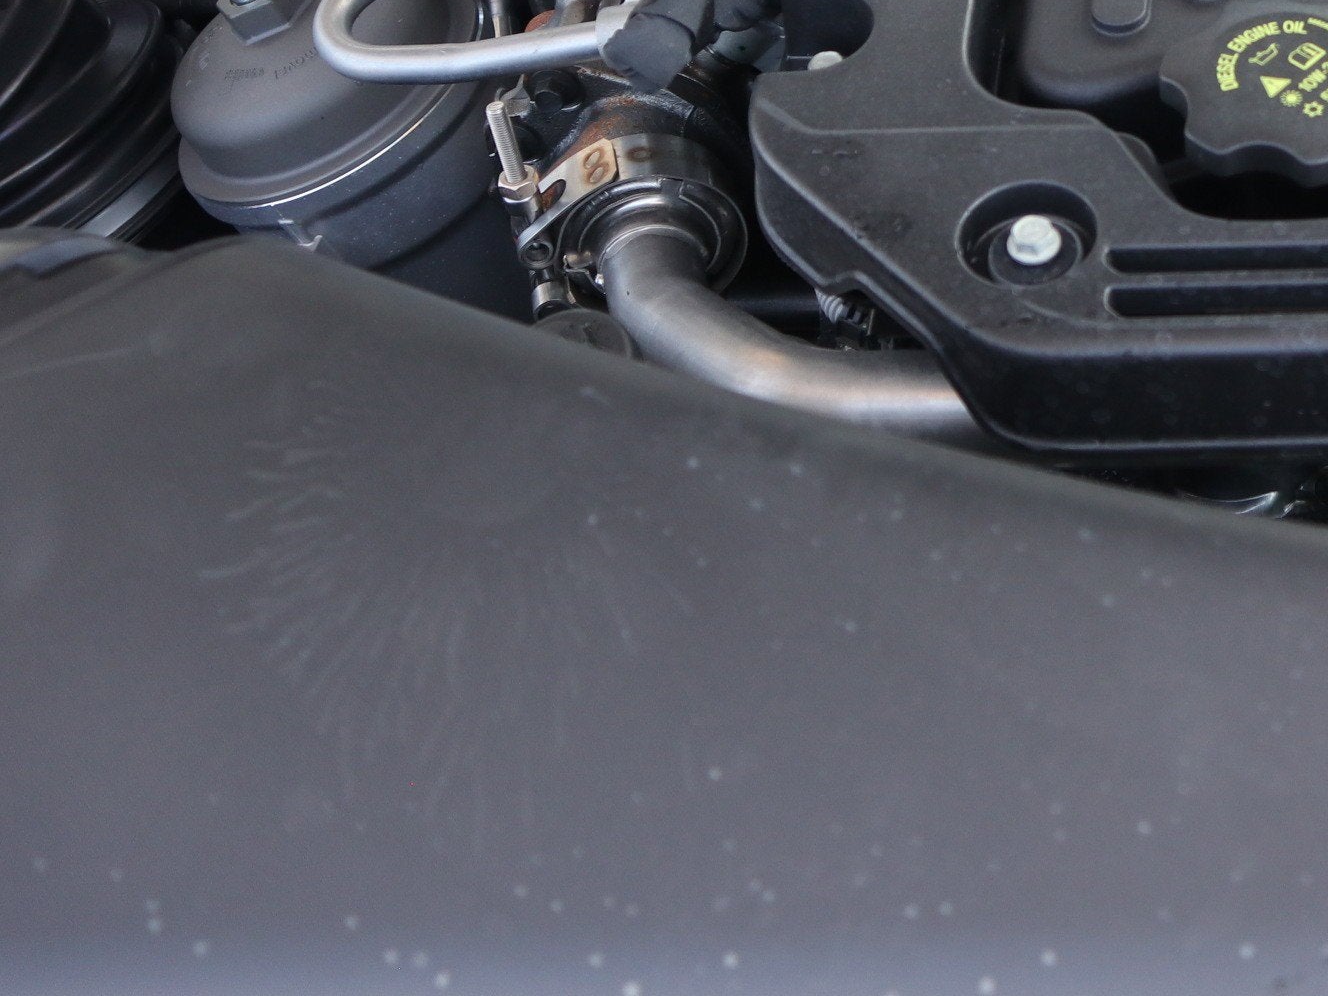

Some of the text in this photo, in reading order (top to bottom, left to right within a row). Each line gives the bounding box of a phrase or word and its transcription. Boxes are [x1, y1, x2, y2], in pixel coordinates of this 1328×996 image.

[1227, 21, 1281, 53] ENGINE
[1283, 20, 1307, 35] OIL
[1216, 53, 1240, 92] DIESEL
